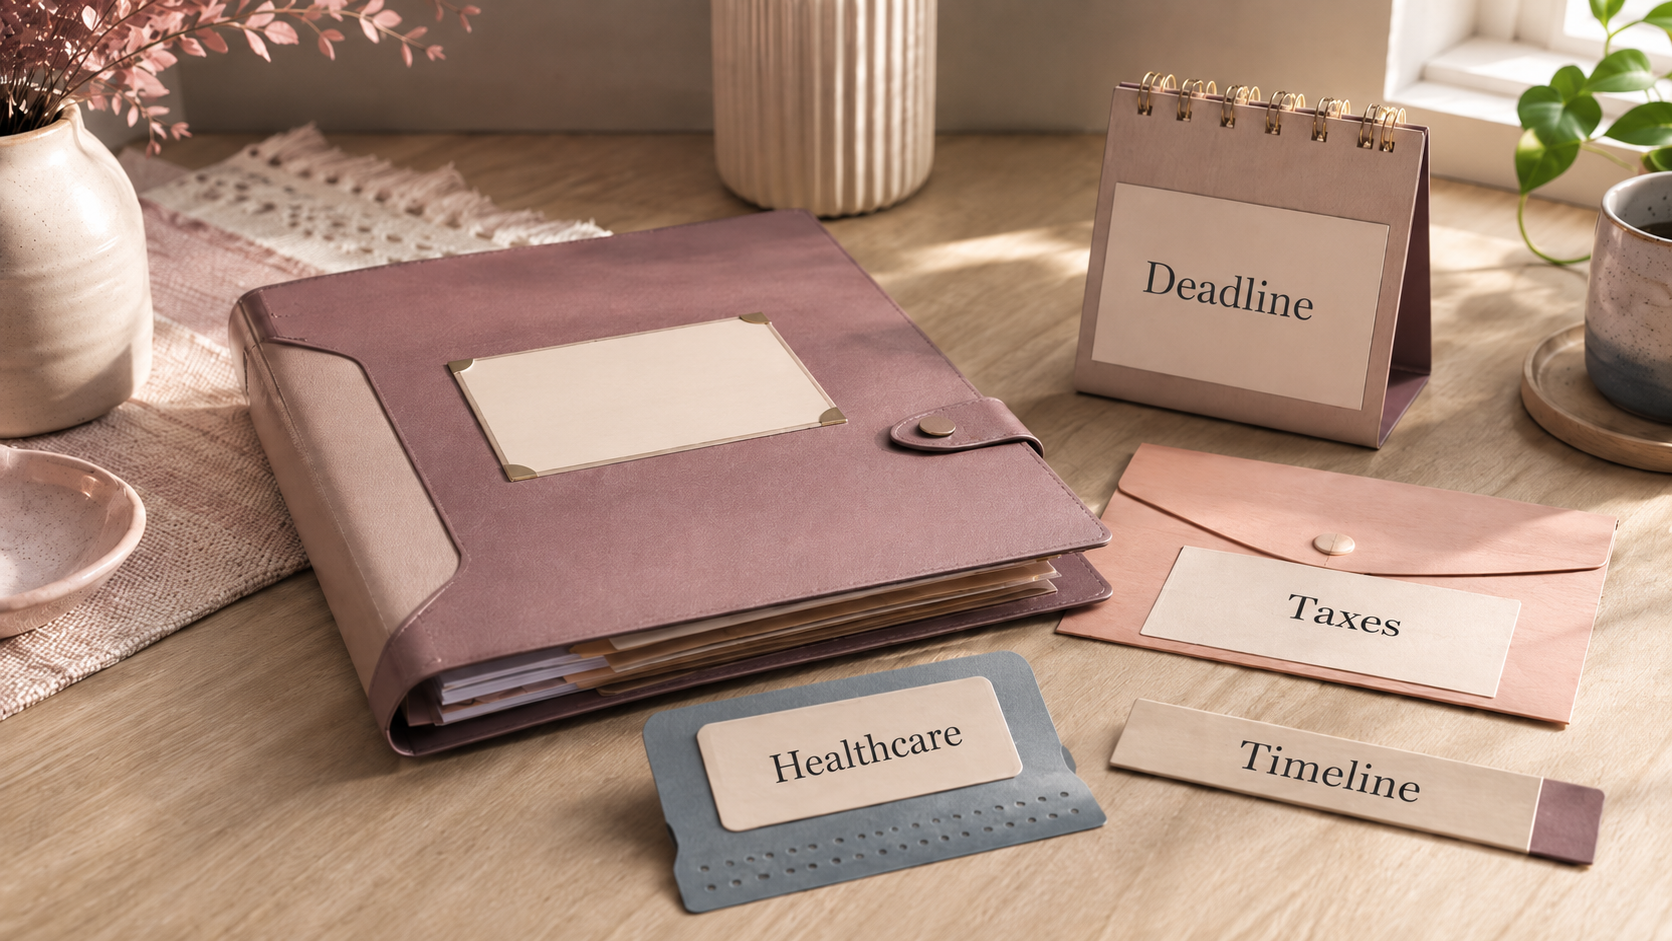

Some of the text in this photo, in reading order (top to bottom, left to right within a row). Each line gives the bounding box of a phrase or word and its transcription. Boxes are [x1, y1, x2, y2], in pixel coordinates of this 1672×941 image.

[1143, 260, 1314, 321] Deadline
[1288, 593, 1401, 637] Taxes
[769, 725, 963, 783] Healthcare
[1239, 740, 1420, 803] Timeline
